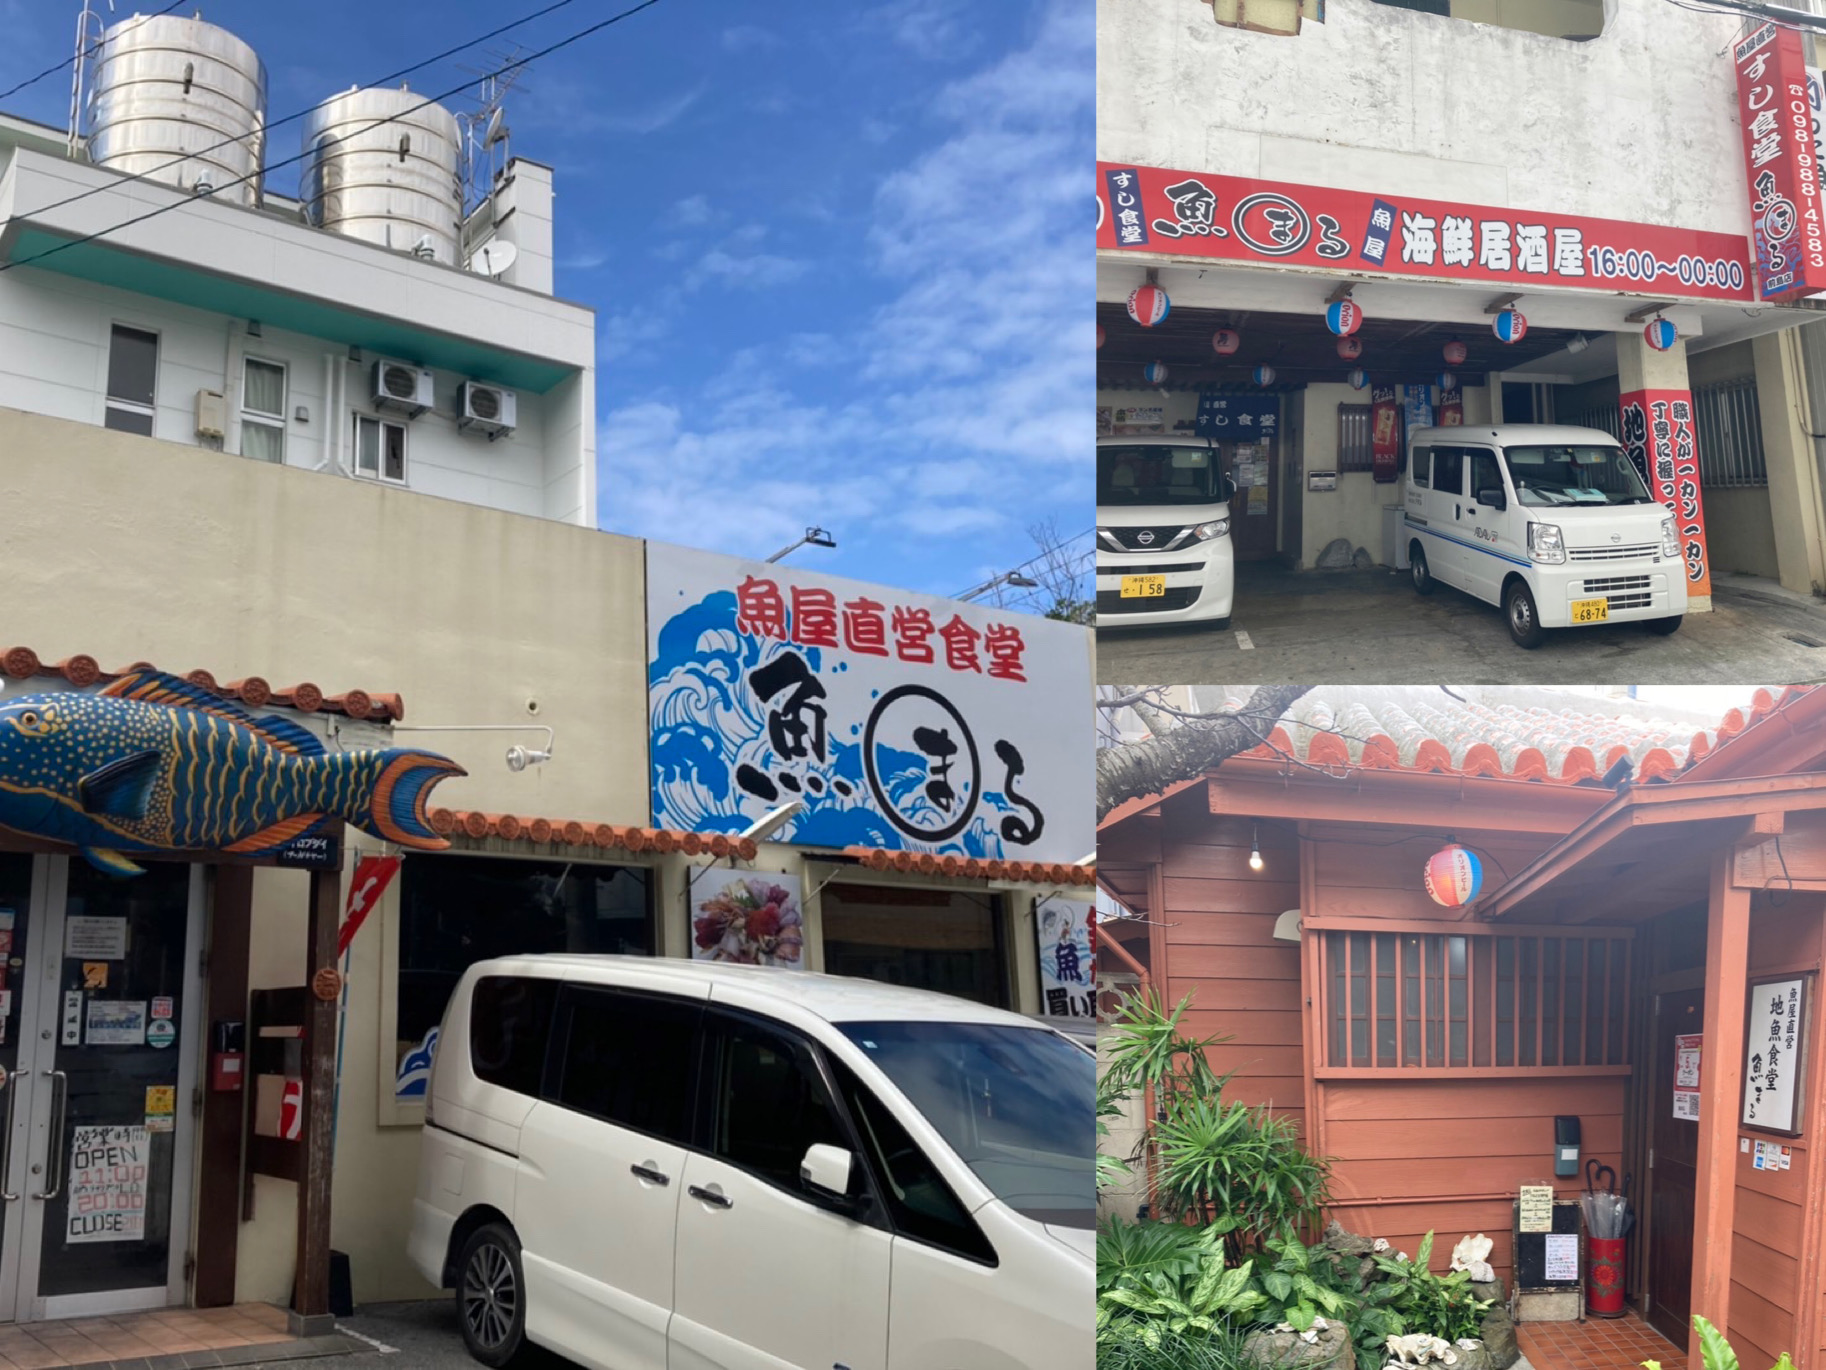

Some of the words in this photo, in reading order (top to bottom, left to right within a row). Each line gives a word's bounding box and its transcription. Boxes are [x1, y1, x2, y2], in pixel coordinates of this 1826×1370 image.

[1742, 52, 1783, 168] すし食堂
[1112, 171, 1144, 245] すし食堂
[1362, 206, 1393, 262] 魚屋
[1401, 211, 1586, 278] 海鮮居酒屋
[1767, 271, 1793, 290] 前島店
[1340, 303, 1351, 328] Orion
[1512, 313, 1521, 335] Orion
[1199, 413, 1277, 427] すし食堂
[1672, 402, 1705, 582] 職人が一カン一カン
[736, 575, 1027, 682] 魚屋直営食堂
[1580, 607, 1606, 621] 68-74
[1765, 994, 1784, 1092] 地魚食堂
[1784, 987, 1798, 1051] 魚屋直営
[75, 1147, 138, 1169] OPEN
[70, 1214, 123, 1236] CLOSE
